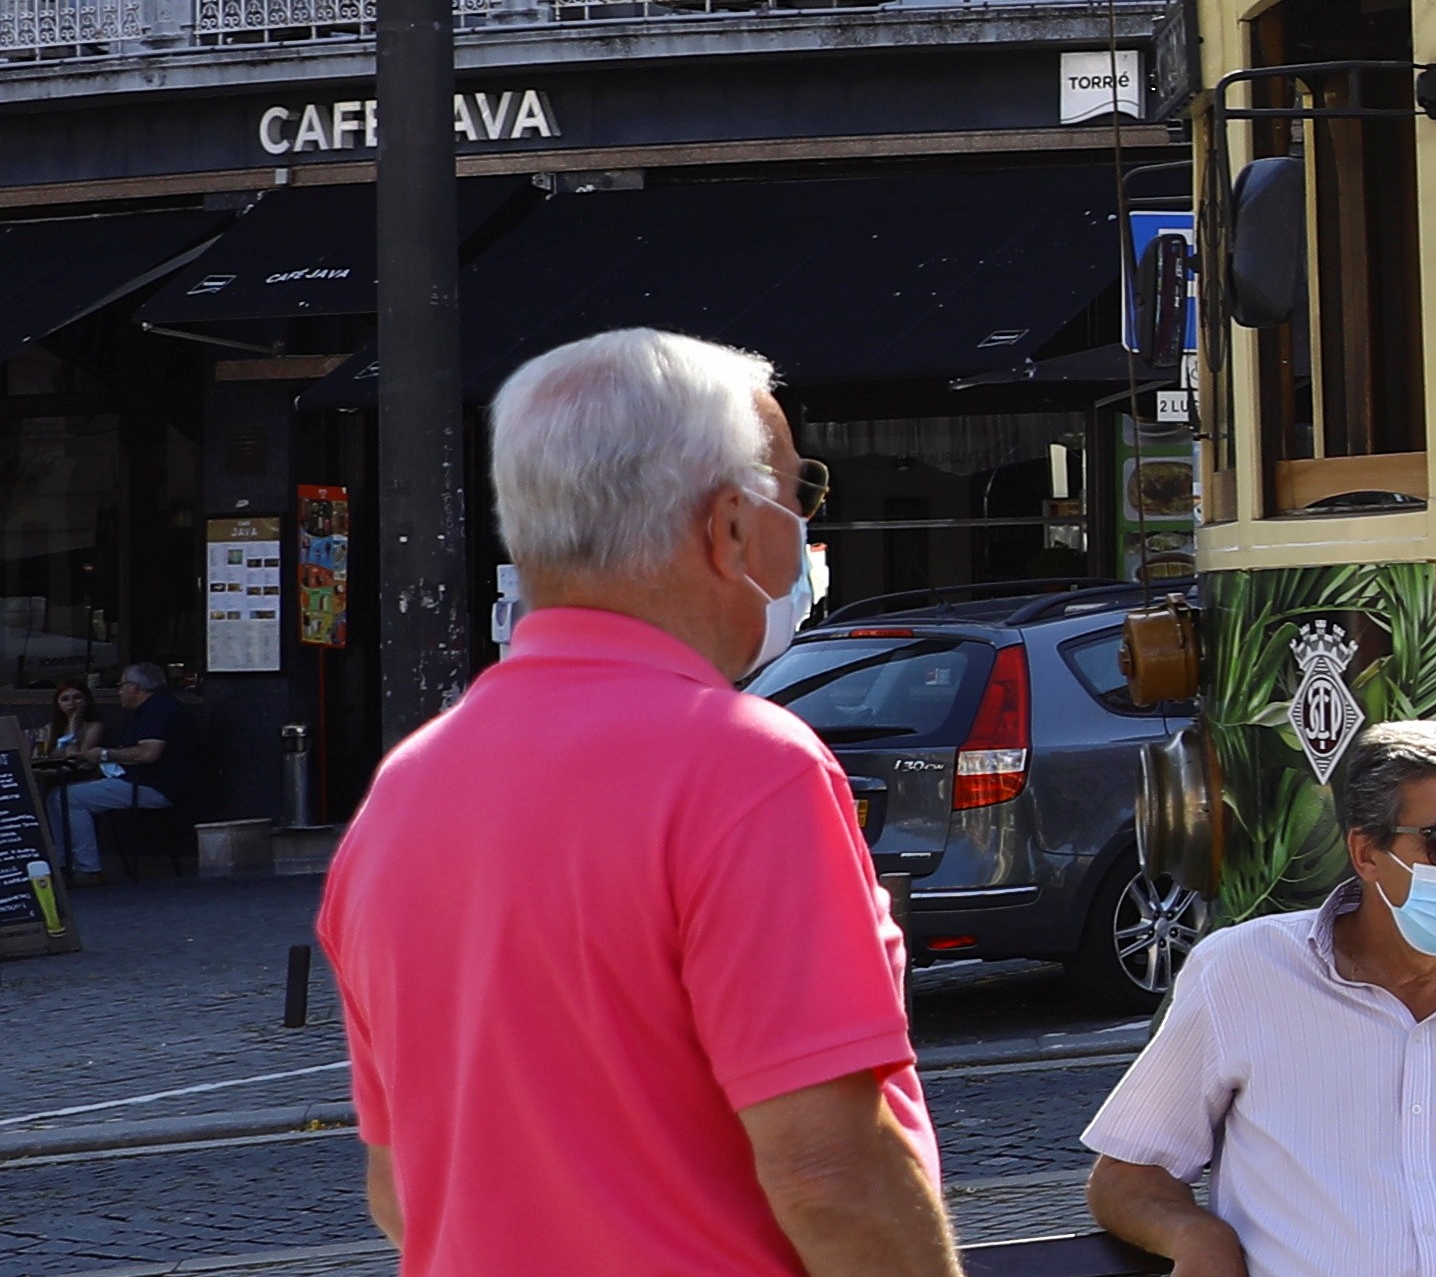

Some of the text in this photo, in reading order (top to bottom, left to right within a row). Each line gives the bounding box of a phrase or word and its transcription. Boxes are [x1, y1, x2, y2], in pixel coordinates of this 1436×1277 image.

[454, 89, 552, 141] AVA
[305, 268, 351, 280] JAVA
[1160, 397, 1167, 413] 2
[230, 527, 258, 537] JAVA
